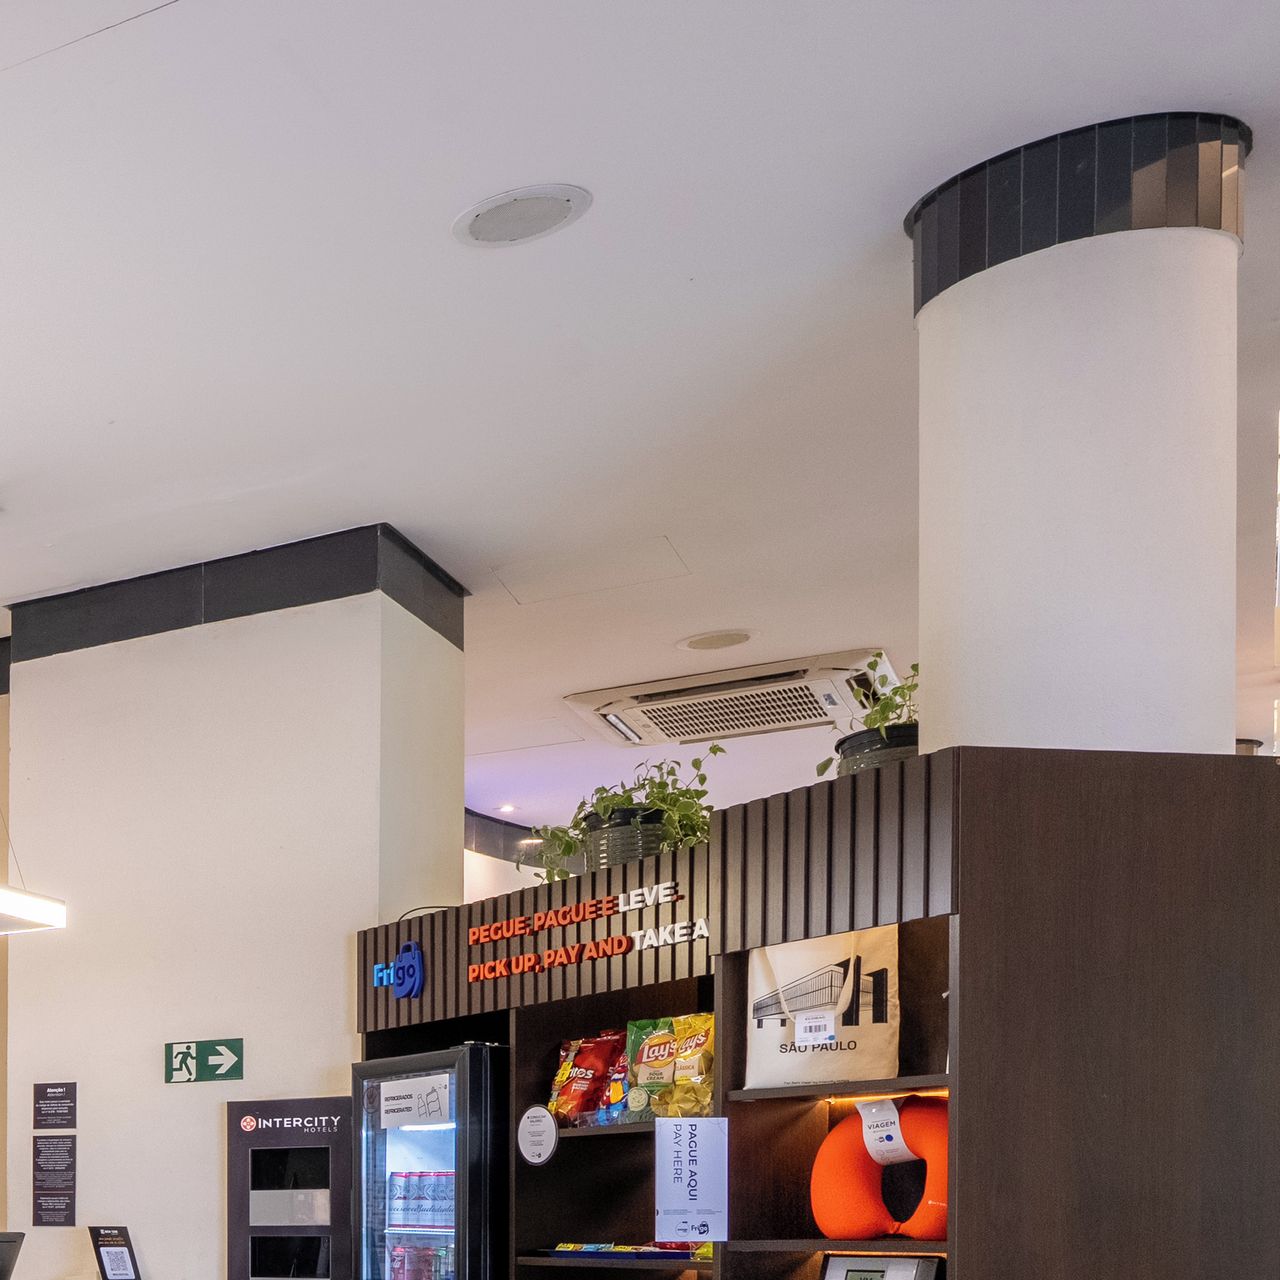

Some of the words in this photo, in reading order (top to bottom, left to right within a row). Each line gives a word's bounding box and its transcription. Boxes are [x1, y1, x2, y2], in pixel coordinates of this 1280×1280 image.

[468, 916, 531, 946] PEGUE,
[534, 899, 597, 931] PAGUE
[602, 896, 614, 916] E
[468, 961, 509, 983] PICK
[512, 953, 541, 974] UP,
[544, 943, 580, 968] PAY
[584, 934, 629, 961] AND
[631, 920, 689, 950] TAKE
[258, 1115, 341, 1129] INTERCITY
[673, 1123, 683, 1147] PAY
[867, 1120, 896, 1130] VIAGEM
[688, 1123, 698, 1166] PAGUE
[673, 1150, 683, 1184] HERE
[687, 1169, 698, 1201] AQUI
